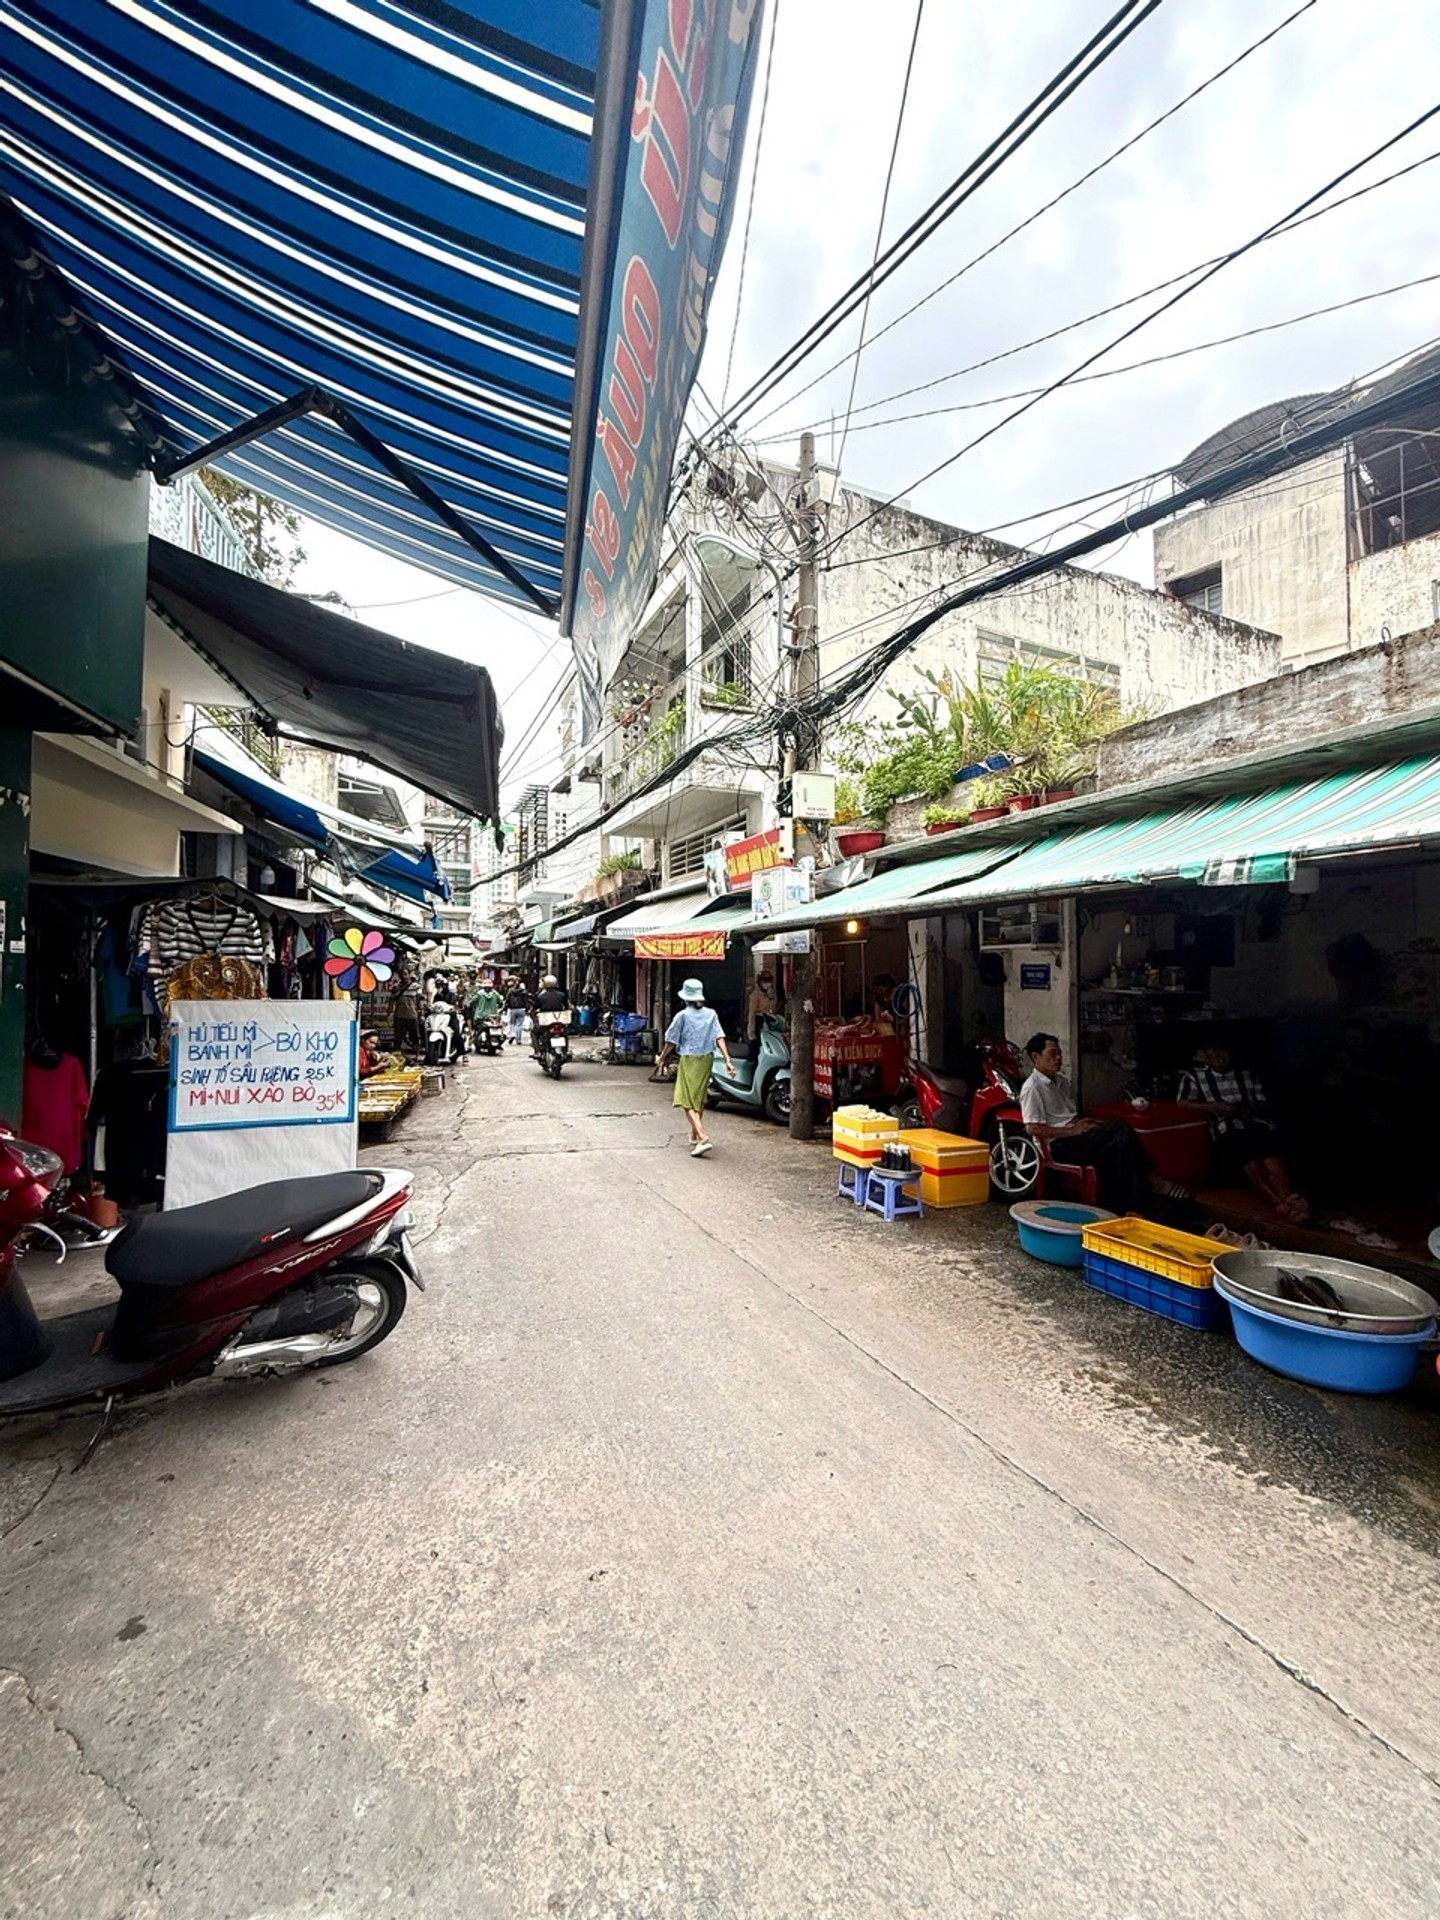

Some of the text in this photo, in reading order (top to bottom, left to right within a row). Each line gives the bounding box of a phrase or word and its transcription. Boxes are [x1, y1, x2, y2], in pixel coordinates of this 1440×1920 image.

[188, 1037, 252, 1061] BÁNH MÌ
[276, 1023, 339, 1052] BÒ KHO
[180, 1067, 211, 1085] SINH
[214, 1062, 231, 1084] TỐ
[304, 1065, 335, 1081] 25K
[247, 1080, 284, 1104] XÀO
[292, 1080, 316, 1102] BÒ
[316, 1089, 346, 1111] 35K
